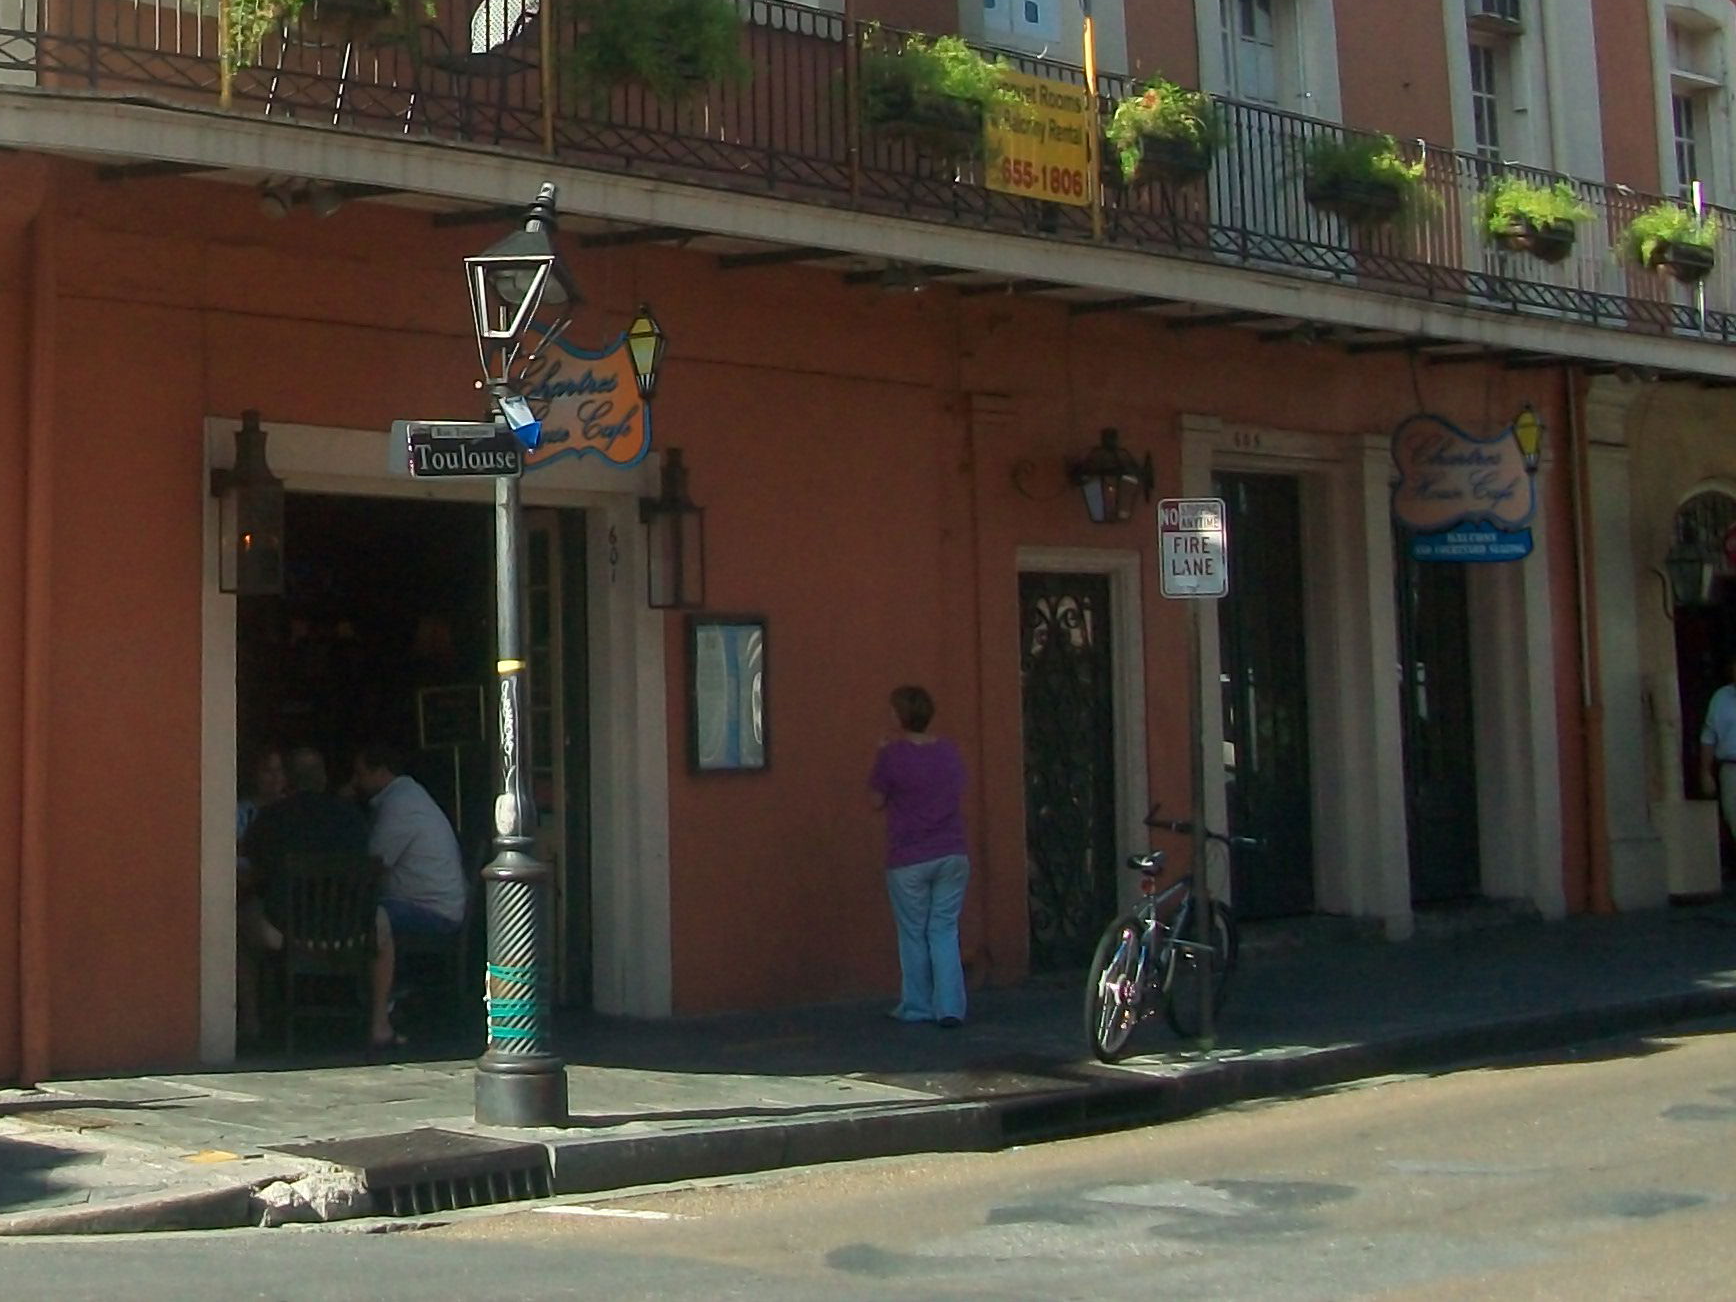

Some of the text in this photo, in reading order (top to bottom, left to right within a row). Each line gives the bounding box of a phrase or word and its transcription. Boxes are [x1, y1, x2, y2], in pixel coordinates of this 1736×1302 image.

[1039, 83, 1083, 114] Rooms
[1001, 154, 1084, 198] 655-1806
[414, 444, 517, 471] Toulouse
[1161, 507, 1179, 526] NO
[1181, 515, 1220, 529] ANYTIME
[1173, 536, 1212, 554] FIRE
[1171, 558, 1215, 576] LANE
